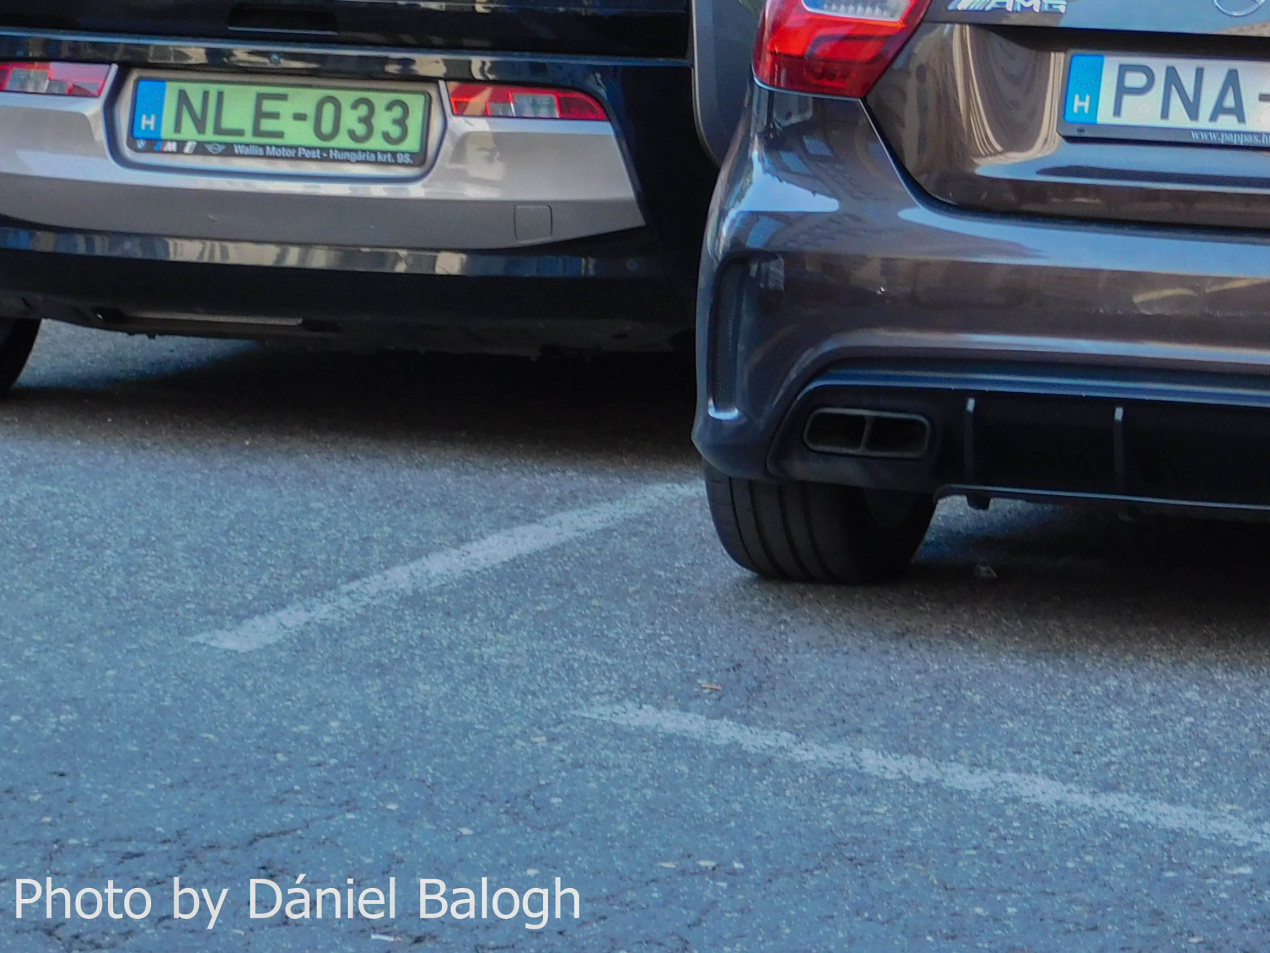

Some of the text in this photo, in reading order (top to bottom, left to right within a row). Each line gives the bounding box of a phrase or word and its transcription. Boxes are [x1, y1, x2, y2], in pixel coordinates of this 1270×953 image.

[1073, 93, 1090, 115] H
[140, 114, 156, 131] H
[173, 89, 411, 145] NLE-033
[234, 144, 264, 156] Wallis
[266, 145, 296, 157] Motor
[298, 147, 321, 159] Pest
[329, 149, 375, 163] Hungária
[377, 151, 395, 163] krt.
